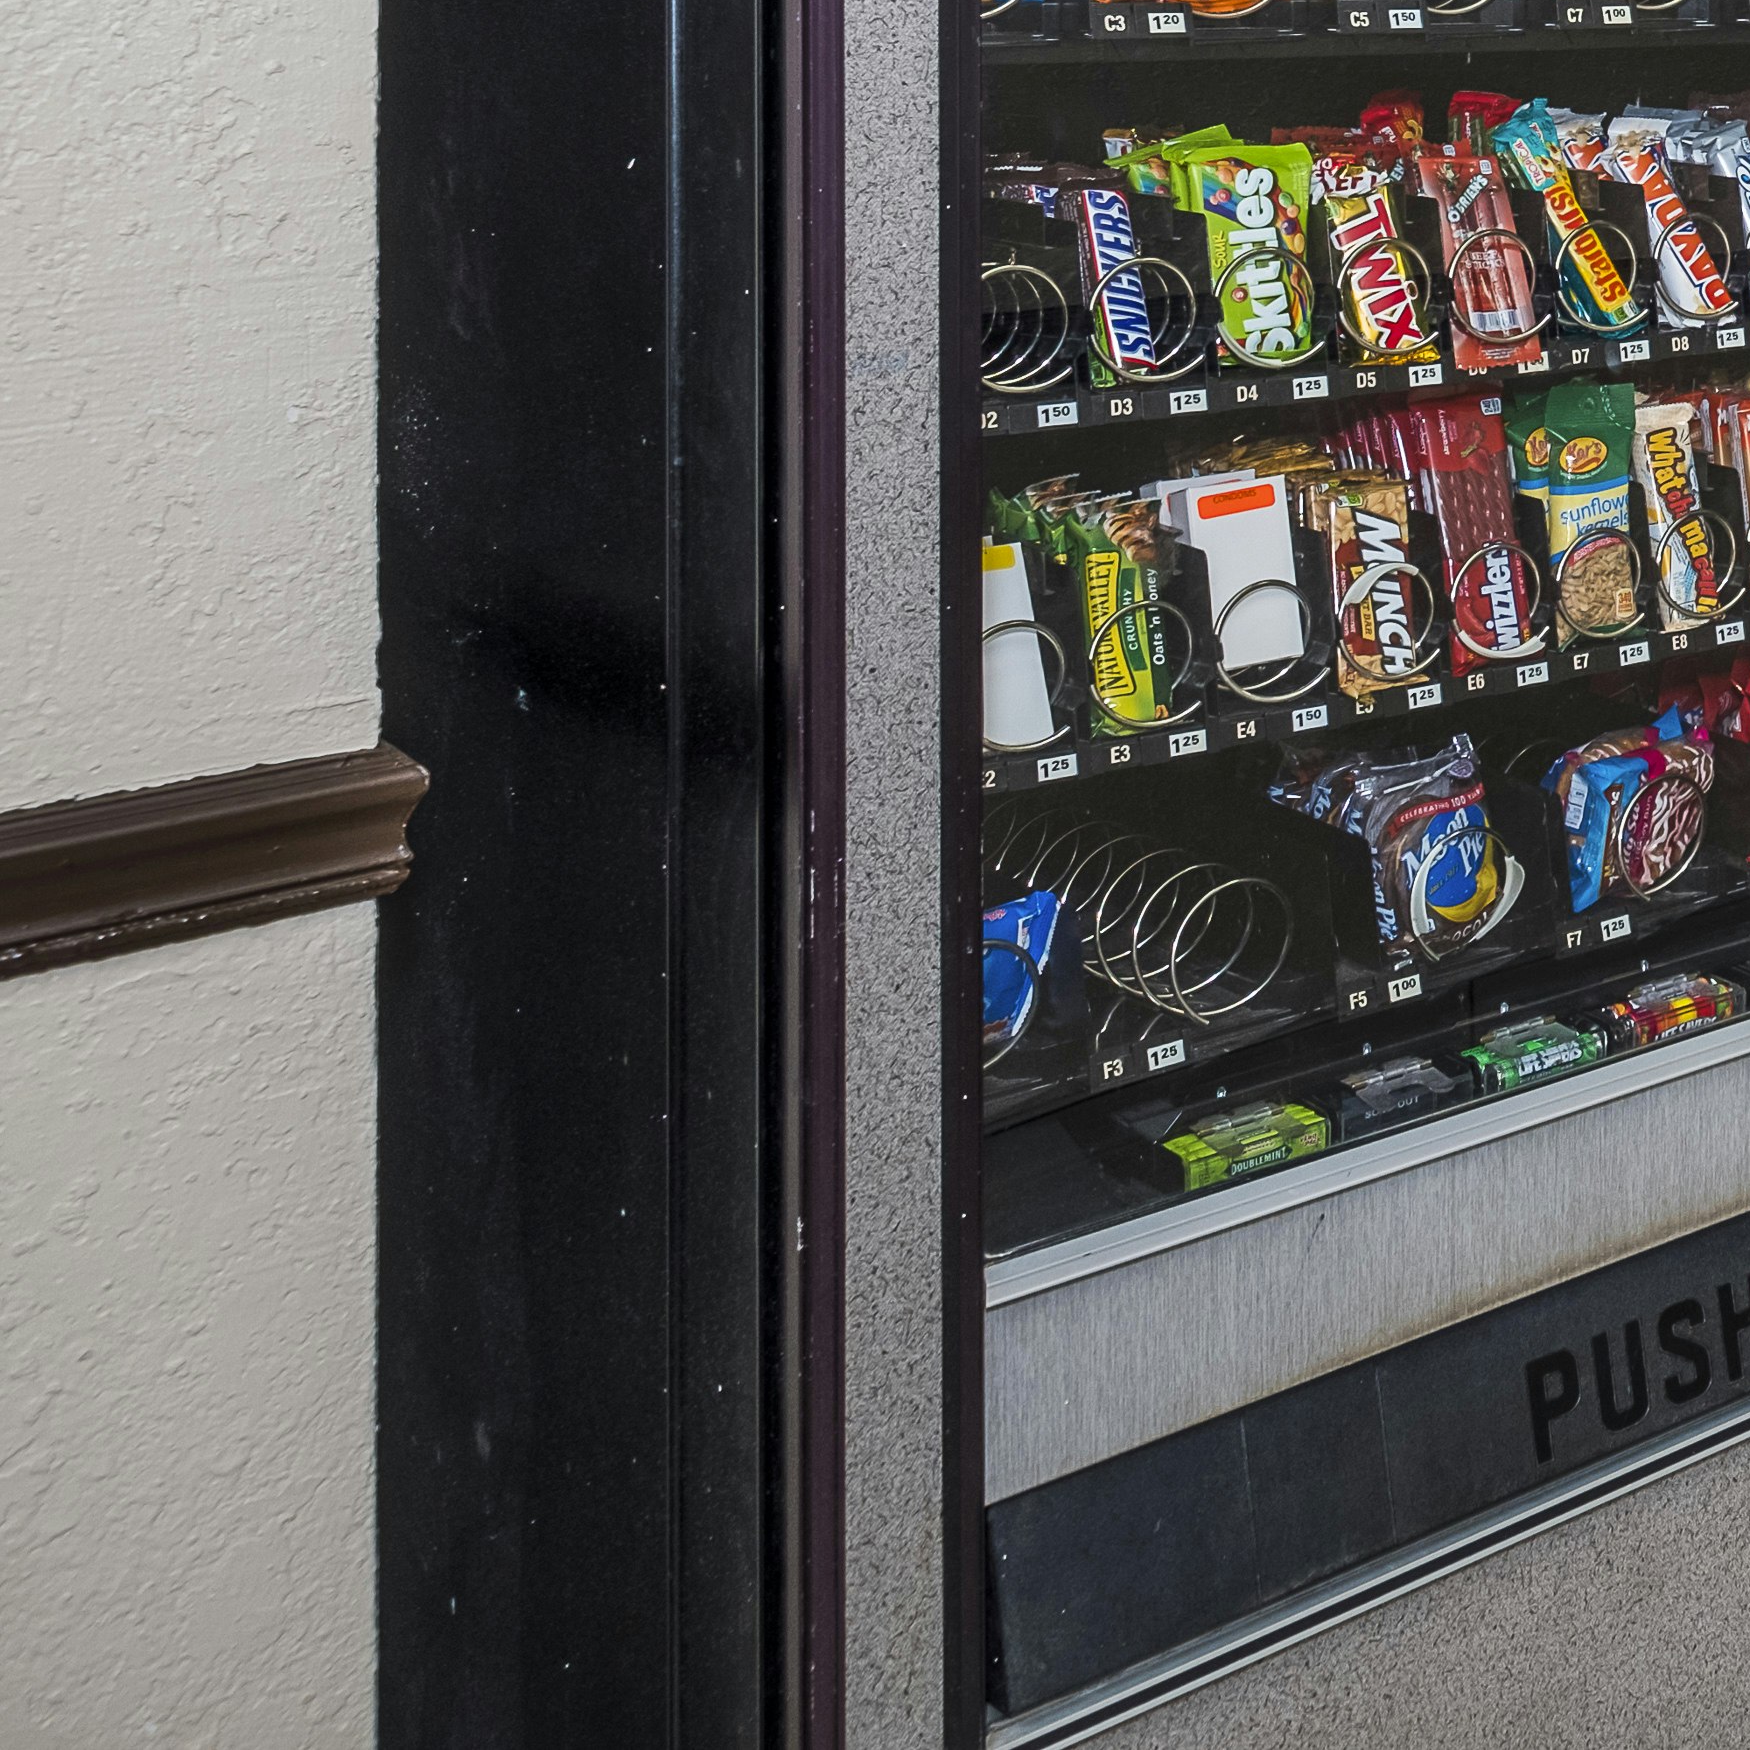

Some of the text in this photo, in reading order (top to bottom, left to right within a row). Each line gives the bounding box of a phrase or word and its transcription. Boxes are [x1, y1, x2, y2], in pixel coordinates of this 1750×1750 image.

[1104, 15, 1126, 32] C3
[1350, 11, 1370, 28] C5
[1567, 7, 1584, 23] C7
[1213, 229, 1228, 269] SOUR
[1085, 191, 1156, 362] SNICKERS
[1331, 193, 1425, 348] TWIX
[1671, 337, 1689, 351] D8
[1572, 348, 1590, 364] D7
[1356, 373, 1376, 389] D5
[1237, 386, 1258, 403] D4
[1111, 399, 1132, 417] D3
[1560, 496, 1630, 526] sunflow
[1086, 557, 1115, 623] VALLEY
[1481, 544, 1521, 652] wizzler
[1124, 588, 1139, 651] CRUNHY
[1153, 634, 1166, 666] Oats
[1672, 635, 1688, 650] E8
[1573, 654, 1589, 670] E7
[1468, 675, 1484, 690] E6
[1237, 722, 1256, 738] E4
[1111, 746, 1131, 763] E3
[1450, 796, 1466, 808] 100
[1458, 829, 1486, 878] Pie
[1567, 931, 1582, 948] F7
[1349, 991, 1368, 1009] F5
[1103, 1061, 1123, 1077] F3
[1230, 1146, 1287, 1175] DOUBLEMINT
